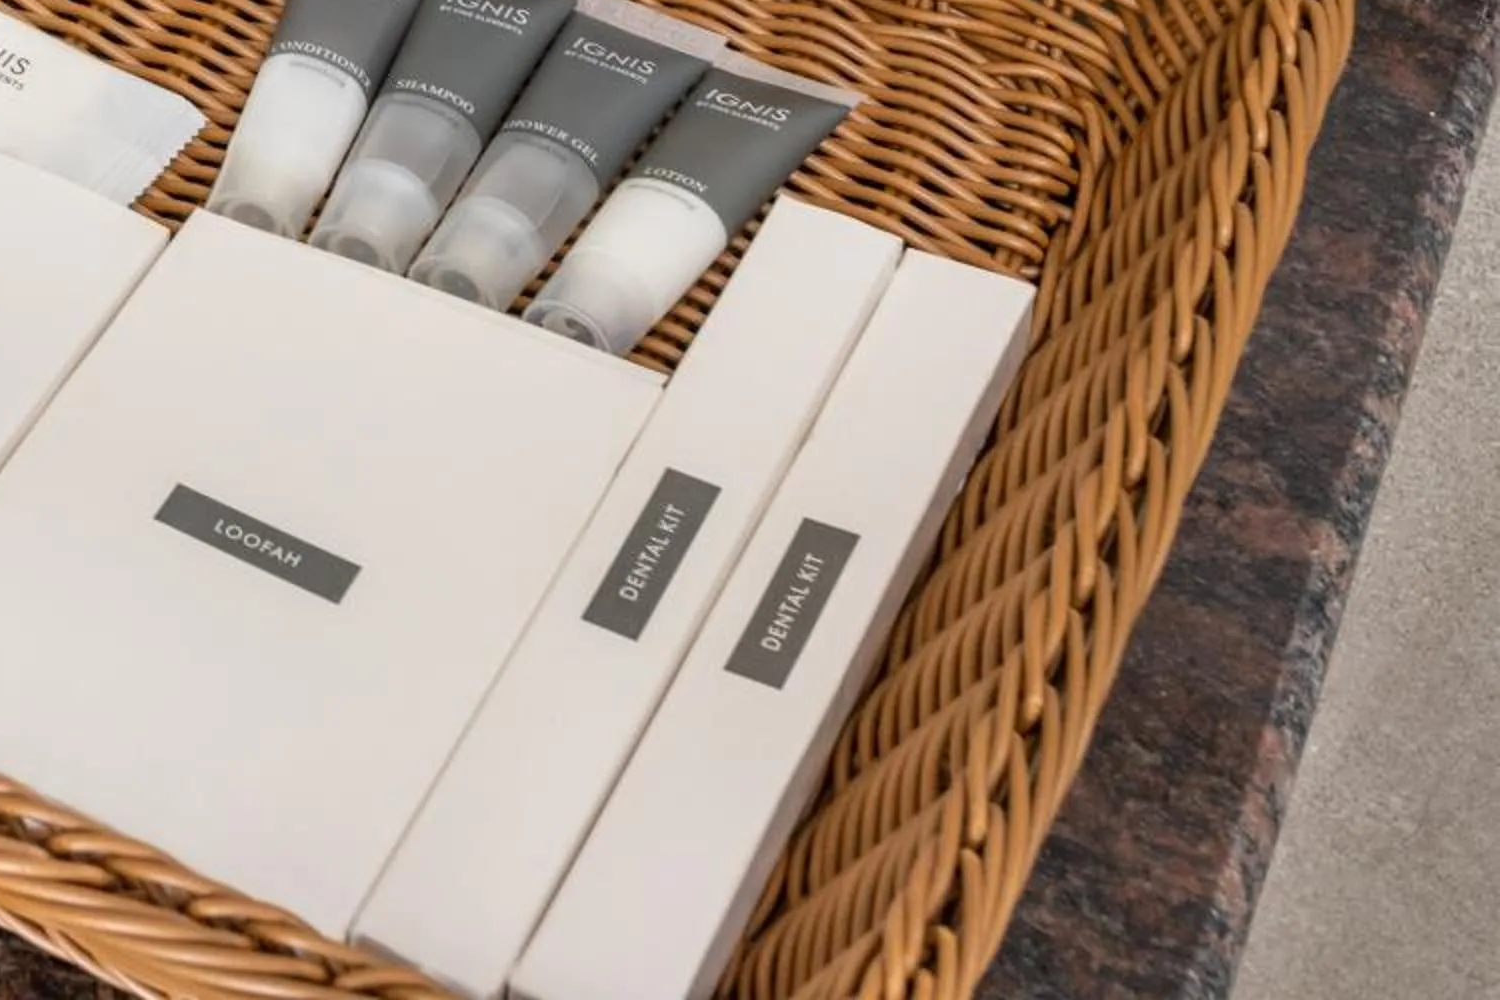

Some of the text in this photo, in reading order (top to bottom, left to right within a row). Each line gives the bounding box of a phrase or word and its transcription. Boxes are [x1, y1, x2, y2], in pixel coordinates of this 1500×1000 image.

[272, 41, 371, 88] ONDITIONER
[572, 37, 657, 75] IGNIS
[396, 80, 475, 115] SHAMPOO
[705, 89, 791, 121] IGNIS
[572, 138, 598, 165] GEL
[644, 167, 708, 192] LOTION
[214, 518, 302, 568] LOOFAH
[619, 503, 685, 602] DENTAL KIT
[761, 552, 824, 652] DENTAL KIT
